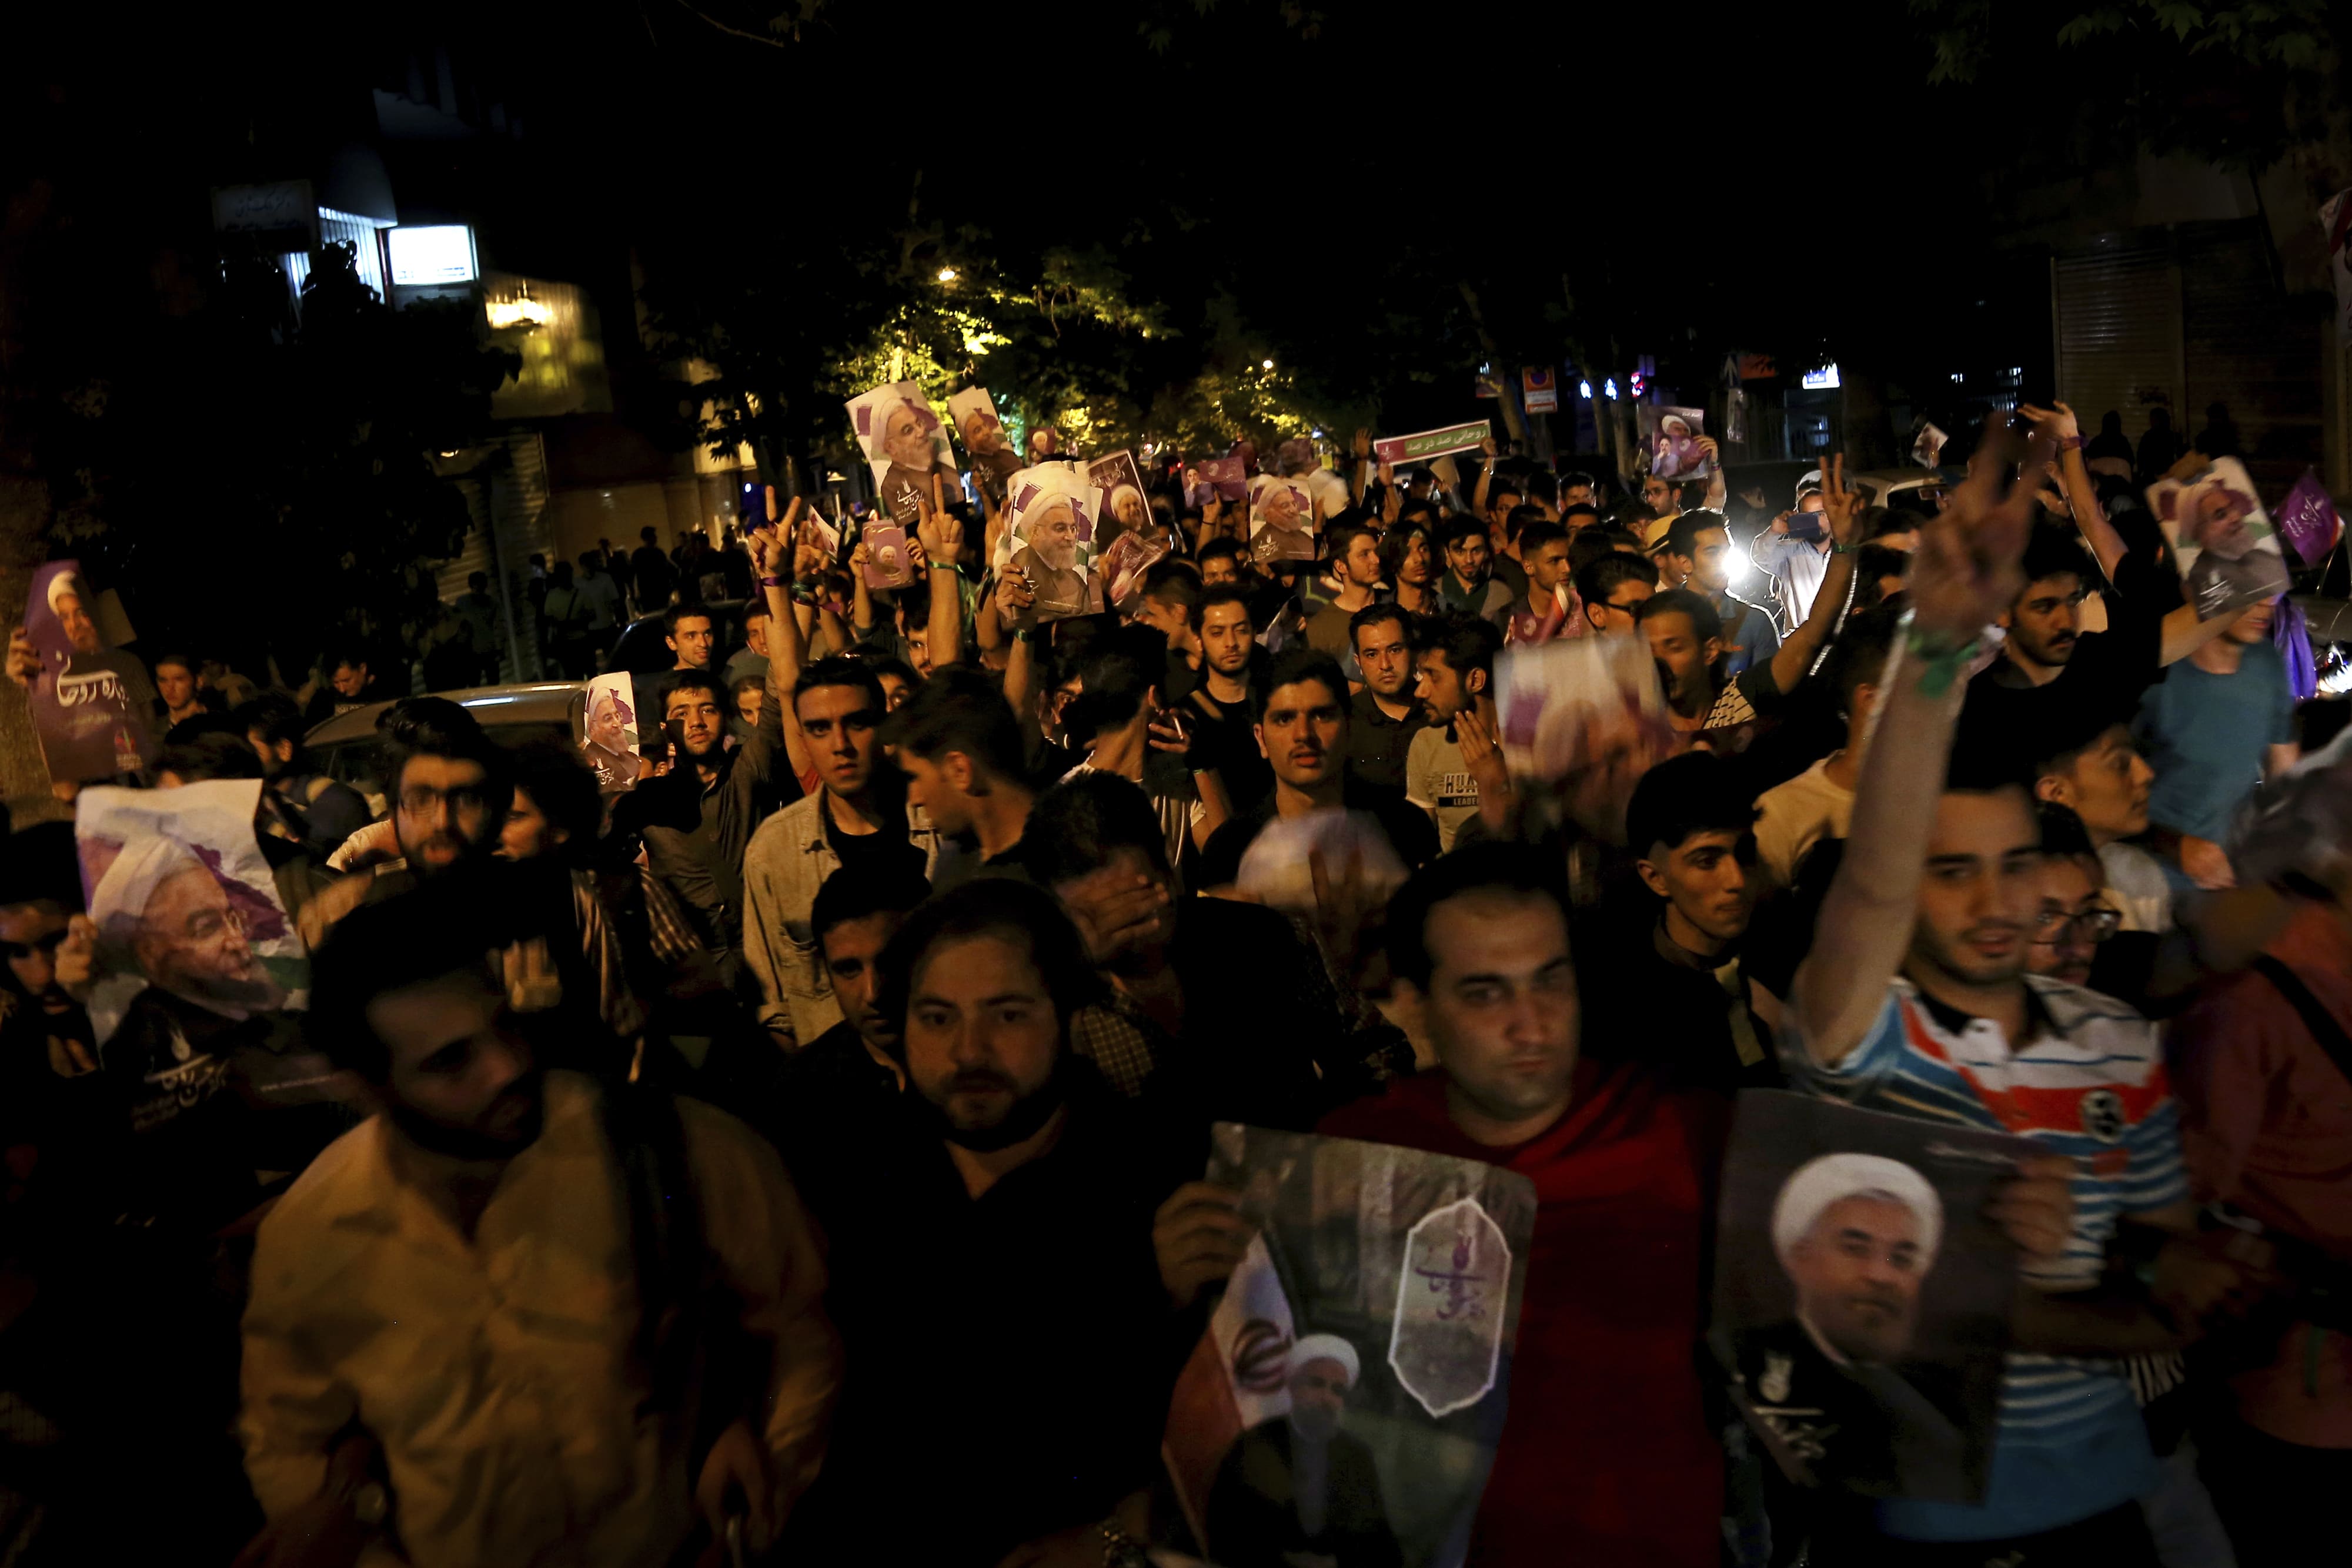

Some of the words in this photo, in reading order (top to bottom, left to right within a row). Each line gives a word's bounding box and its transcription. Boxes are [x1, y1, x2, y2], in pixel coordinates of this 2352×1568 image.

[1436, 436, 1452, 446] صد
[1453, 429, 1486, 444] روحانی
[1453, 797, 1478, 806] LEADE
